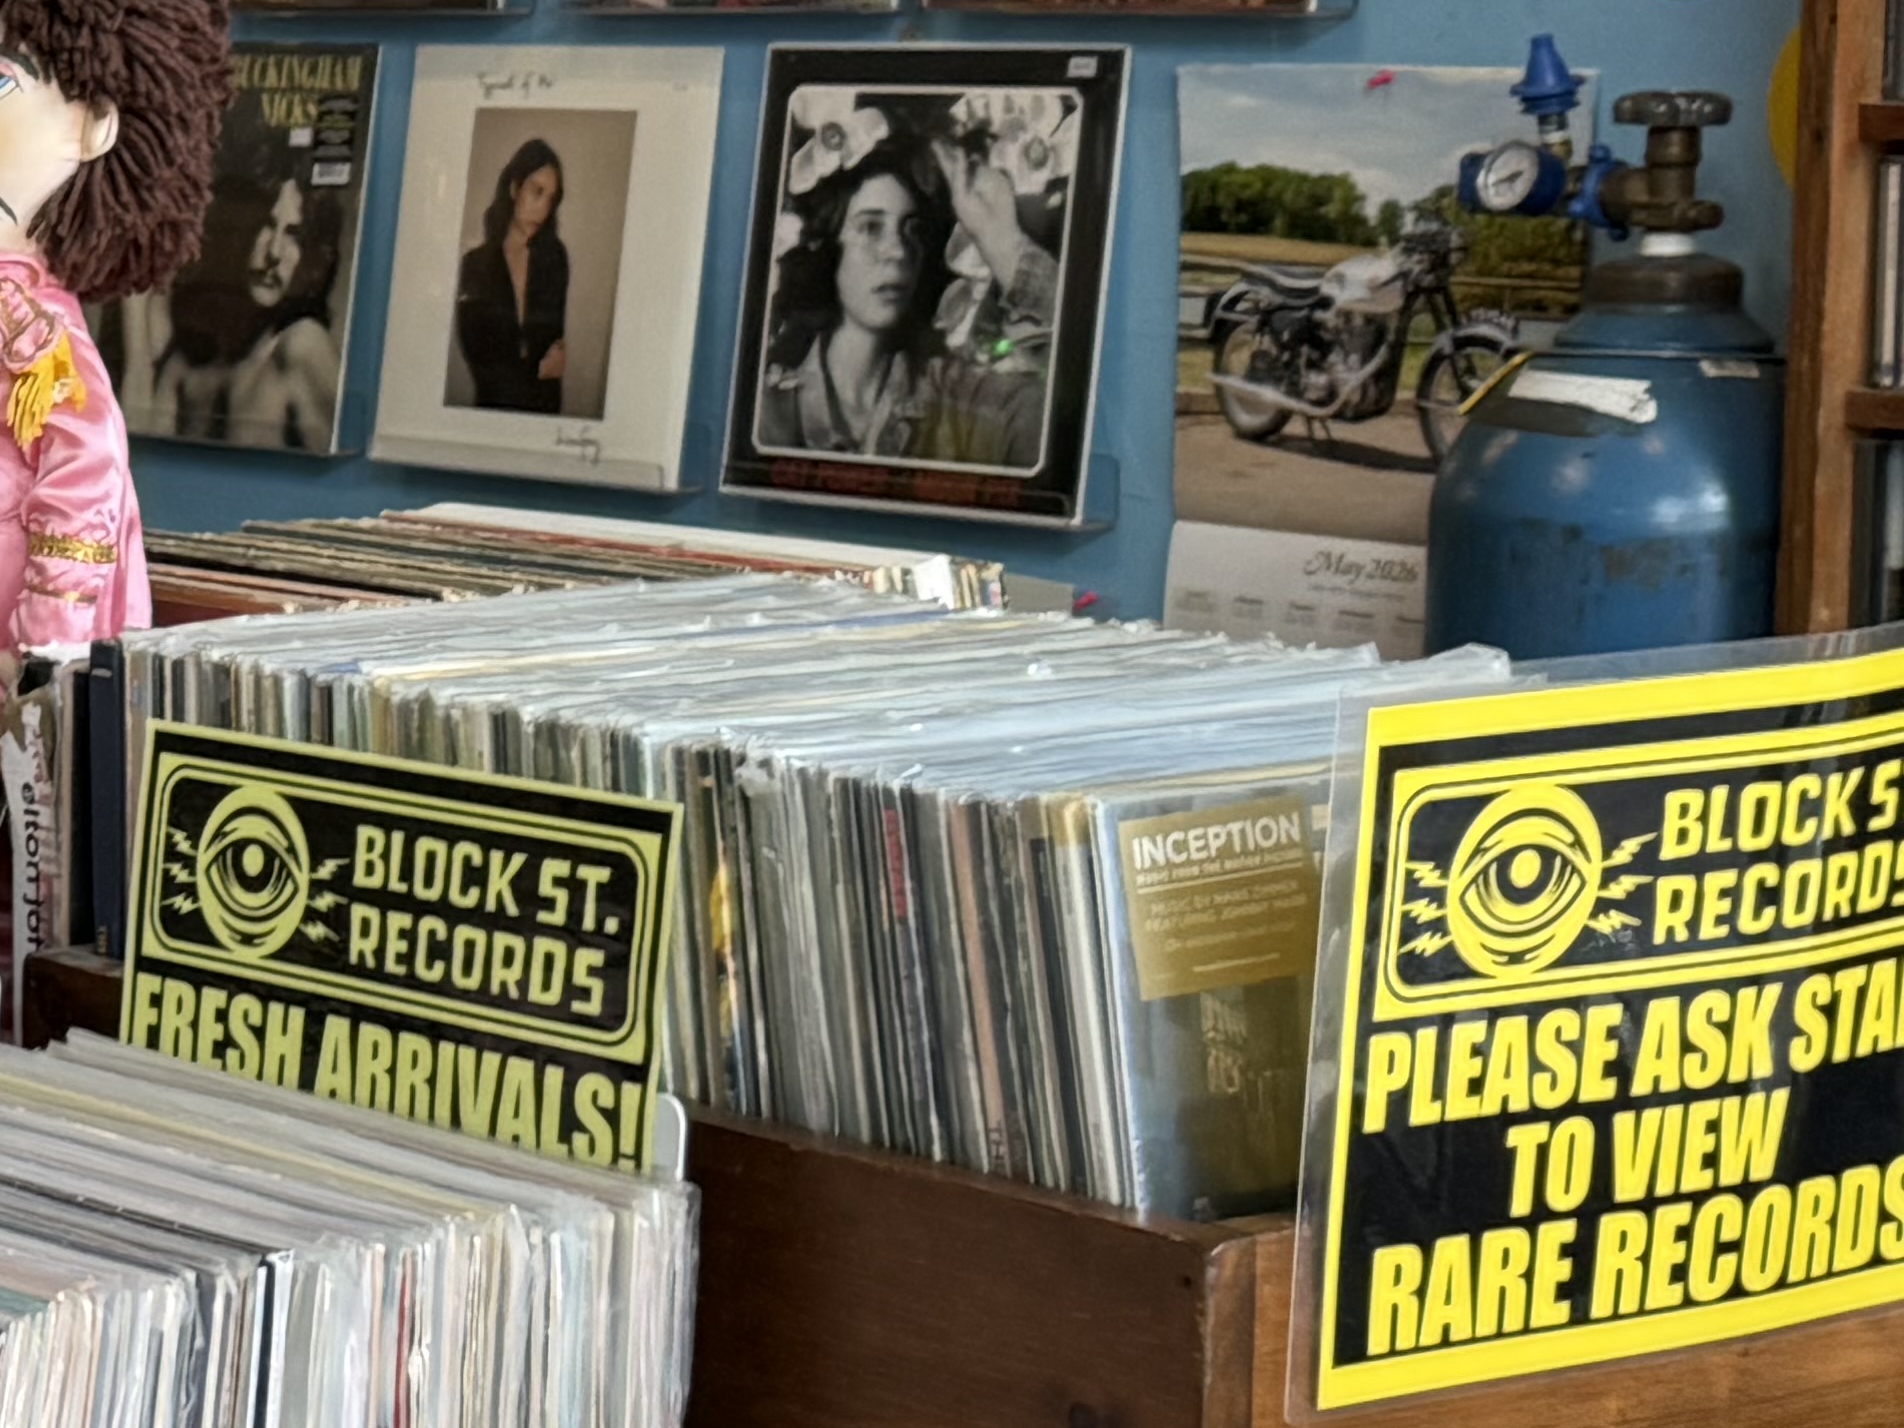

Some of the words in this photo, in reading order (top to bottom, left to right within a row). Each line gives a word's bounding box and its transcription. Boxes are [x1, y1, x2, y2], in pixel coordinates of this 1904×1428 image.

[228, 54, 365, 91] UCKINGHAM
[1303, 550, 1364, 585] May
[21, 781, 43, 880] elton
[1131, 811, 1302, 871] INCEPTION
[1657, 765, 1866, 862] BLOCK
[1867, 758, 1904, 832] S
[351, 823, 530, 918] BLOCK
[535, 856, 622, 937] ST.
[348, 901, 606, 1017] RECORDS
[131, 970, 306, 1092] FRESH
[312, 1012, 644, 1172] ARRIVALS!
[1362, 1003, 1624, 1135] PLEASE
[1630, 981, 1784, 1098] ASK
[1788, 956, 1904, 1074] STA
[1505, 1114, 1596, 1219] TO
[1612, 1085, 1791, 1204] VIEW
[1366, 1216, 1578, 1357] RARE
